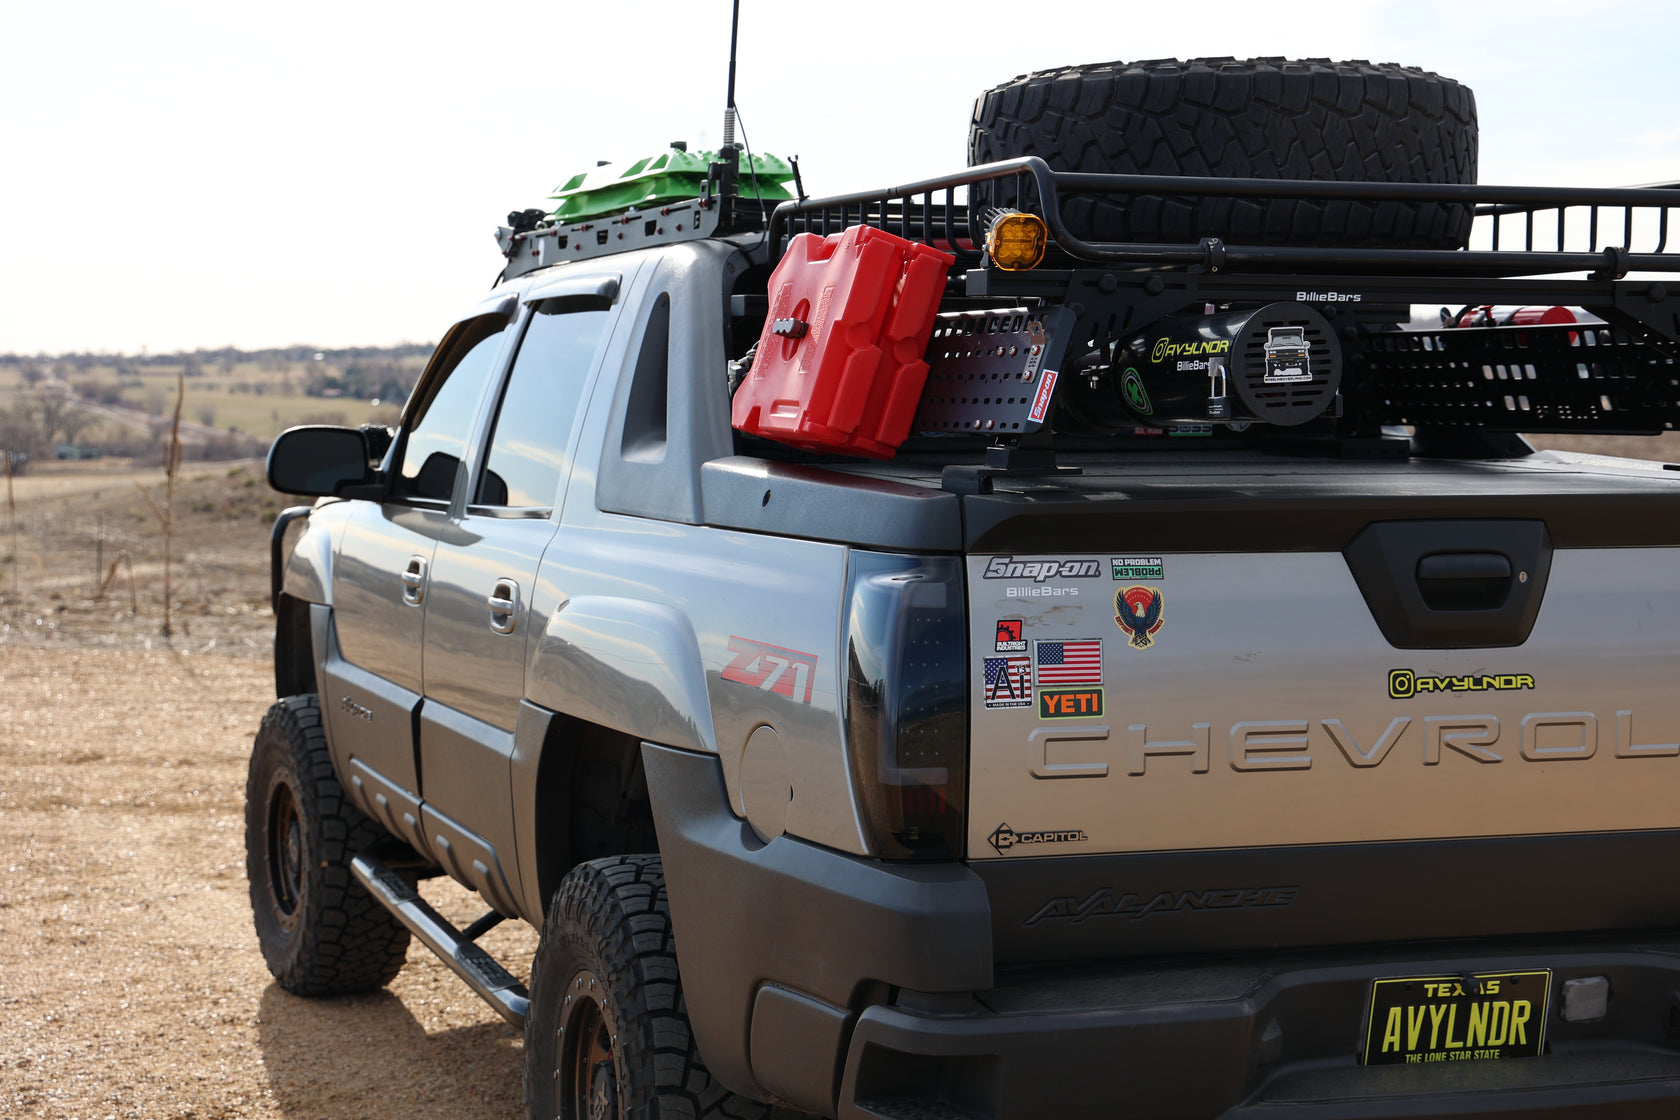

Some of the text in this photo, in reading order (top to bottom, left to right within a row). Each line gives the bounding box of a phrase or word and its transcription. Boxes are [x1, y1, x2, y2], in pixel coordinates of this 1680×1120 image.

[1296, 291, 1362, 302] BillieBars
[1033, 373, 1054, 419] Snap-on
[984, 556, 1102, 582] Snap-on
[1112, 558, 1161, 566] NO PROBLEM
[1006, 586, 1079, 598] BillieBars
[721, 635, 819, 704] Z71
[1016, 665, 1027, 674] 13
[1043, 693, 1099, 714] YETI
[1020, 831, 1089, 844] CAPITOL
[1022, 886, 1304, 927] AVALANCHE
[1381, 1000, 1532, 1053] AVYLNDR
[1405, 1049, 1500, 1063] THE LONE STAR STATE
